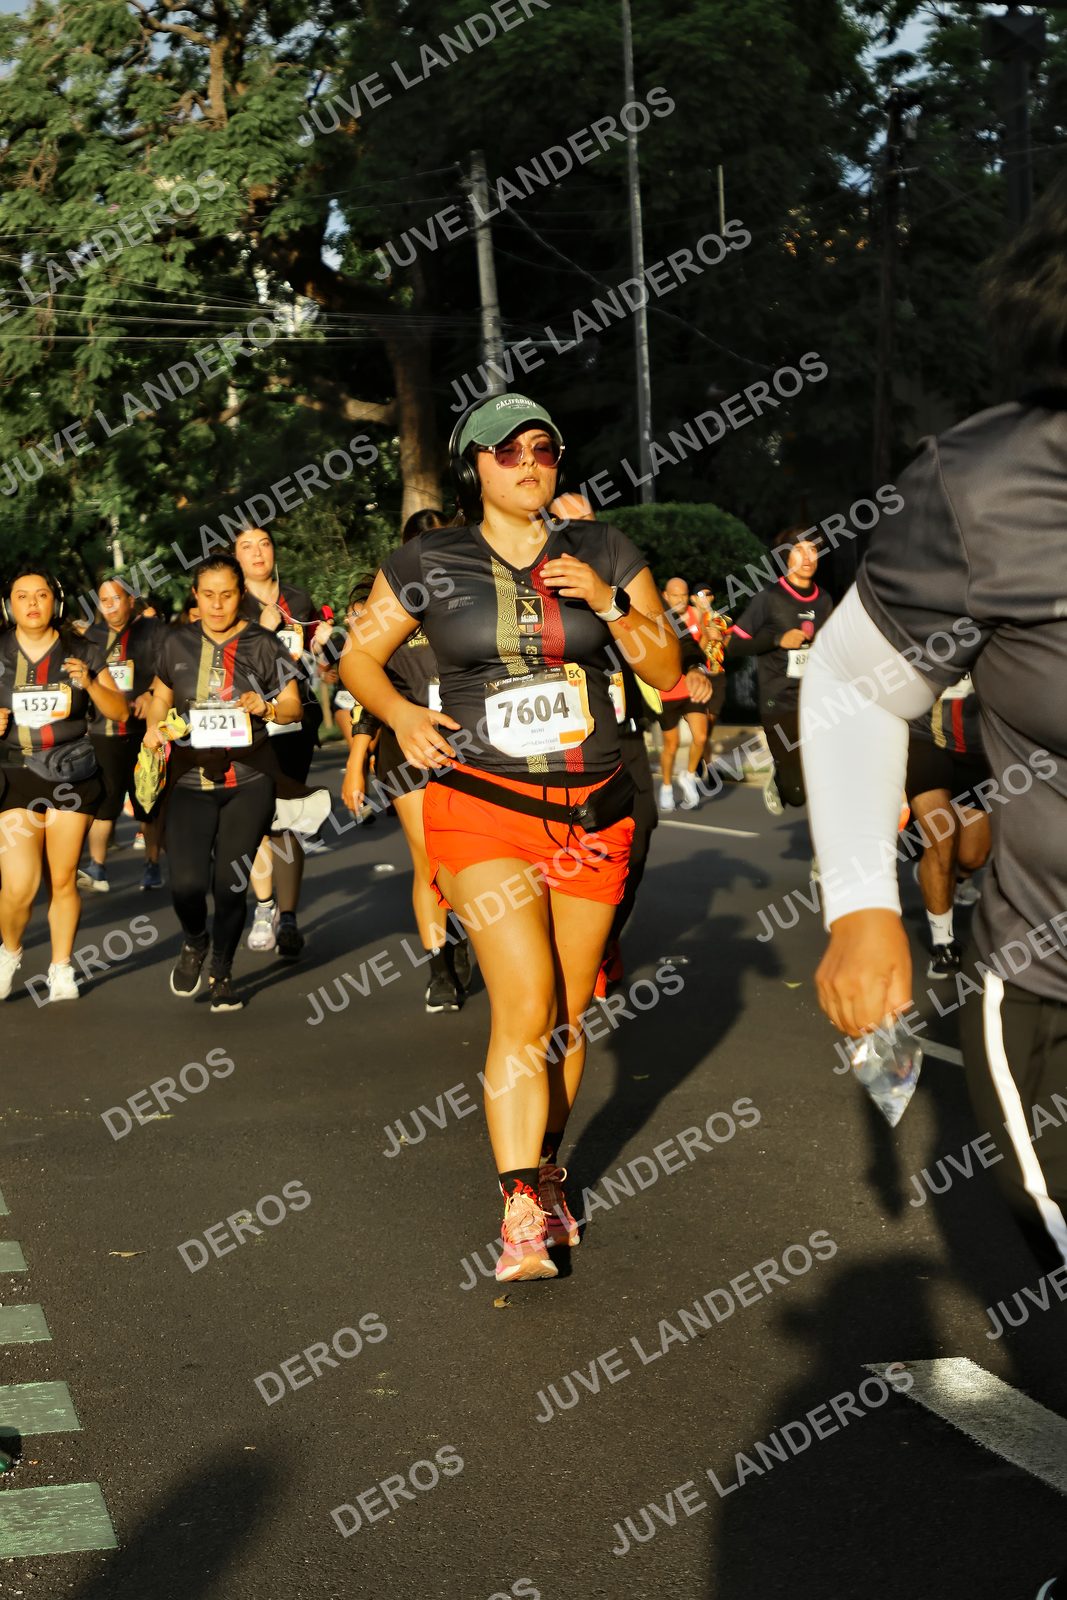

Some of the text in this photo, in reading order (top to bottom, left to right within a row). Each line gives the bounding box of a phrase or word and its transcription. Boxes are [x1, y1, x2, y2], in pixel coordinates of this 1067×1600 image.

[111, 669, 126, 679] 85
[568, 669, 582, 679] 5K
[21, 696, 59, 712] 1537
[497, 691, 571, 729] 7604
[198, 714, 237, 730] 4521
